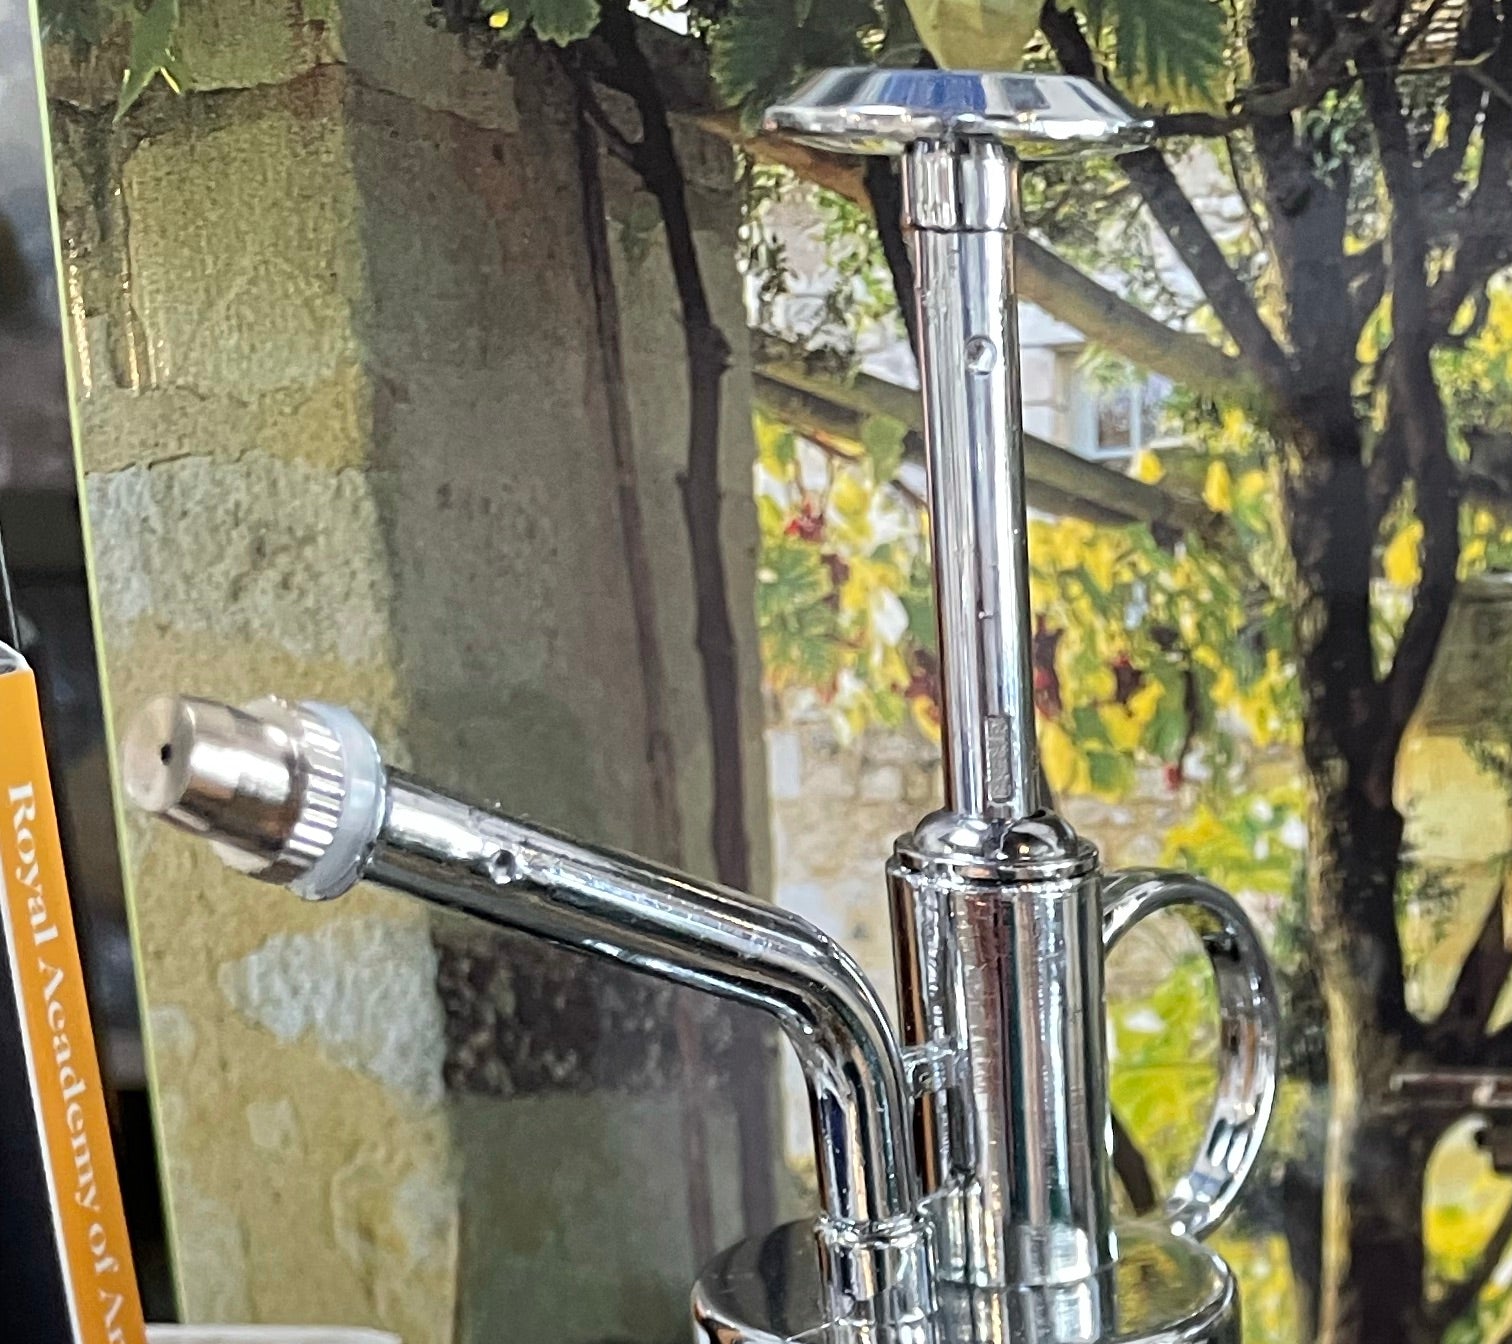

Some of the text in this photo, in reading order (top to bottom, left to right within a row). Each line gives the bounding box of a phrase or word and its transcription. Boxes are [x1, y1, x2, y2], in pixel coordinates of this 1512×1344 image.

[8, 781, 58, 947] Royal
[38, 956, 100, 1213] Academy
[88, 1221, 119, 1273] of
